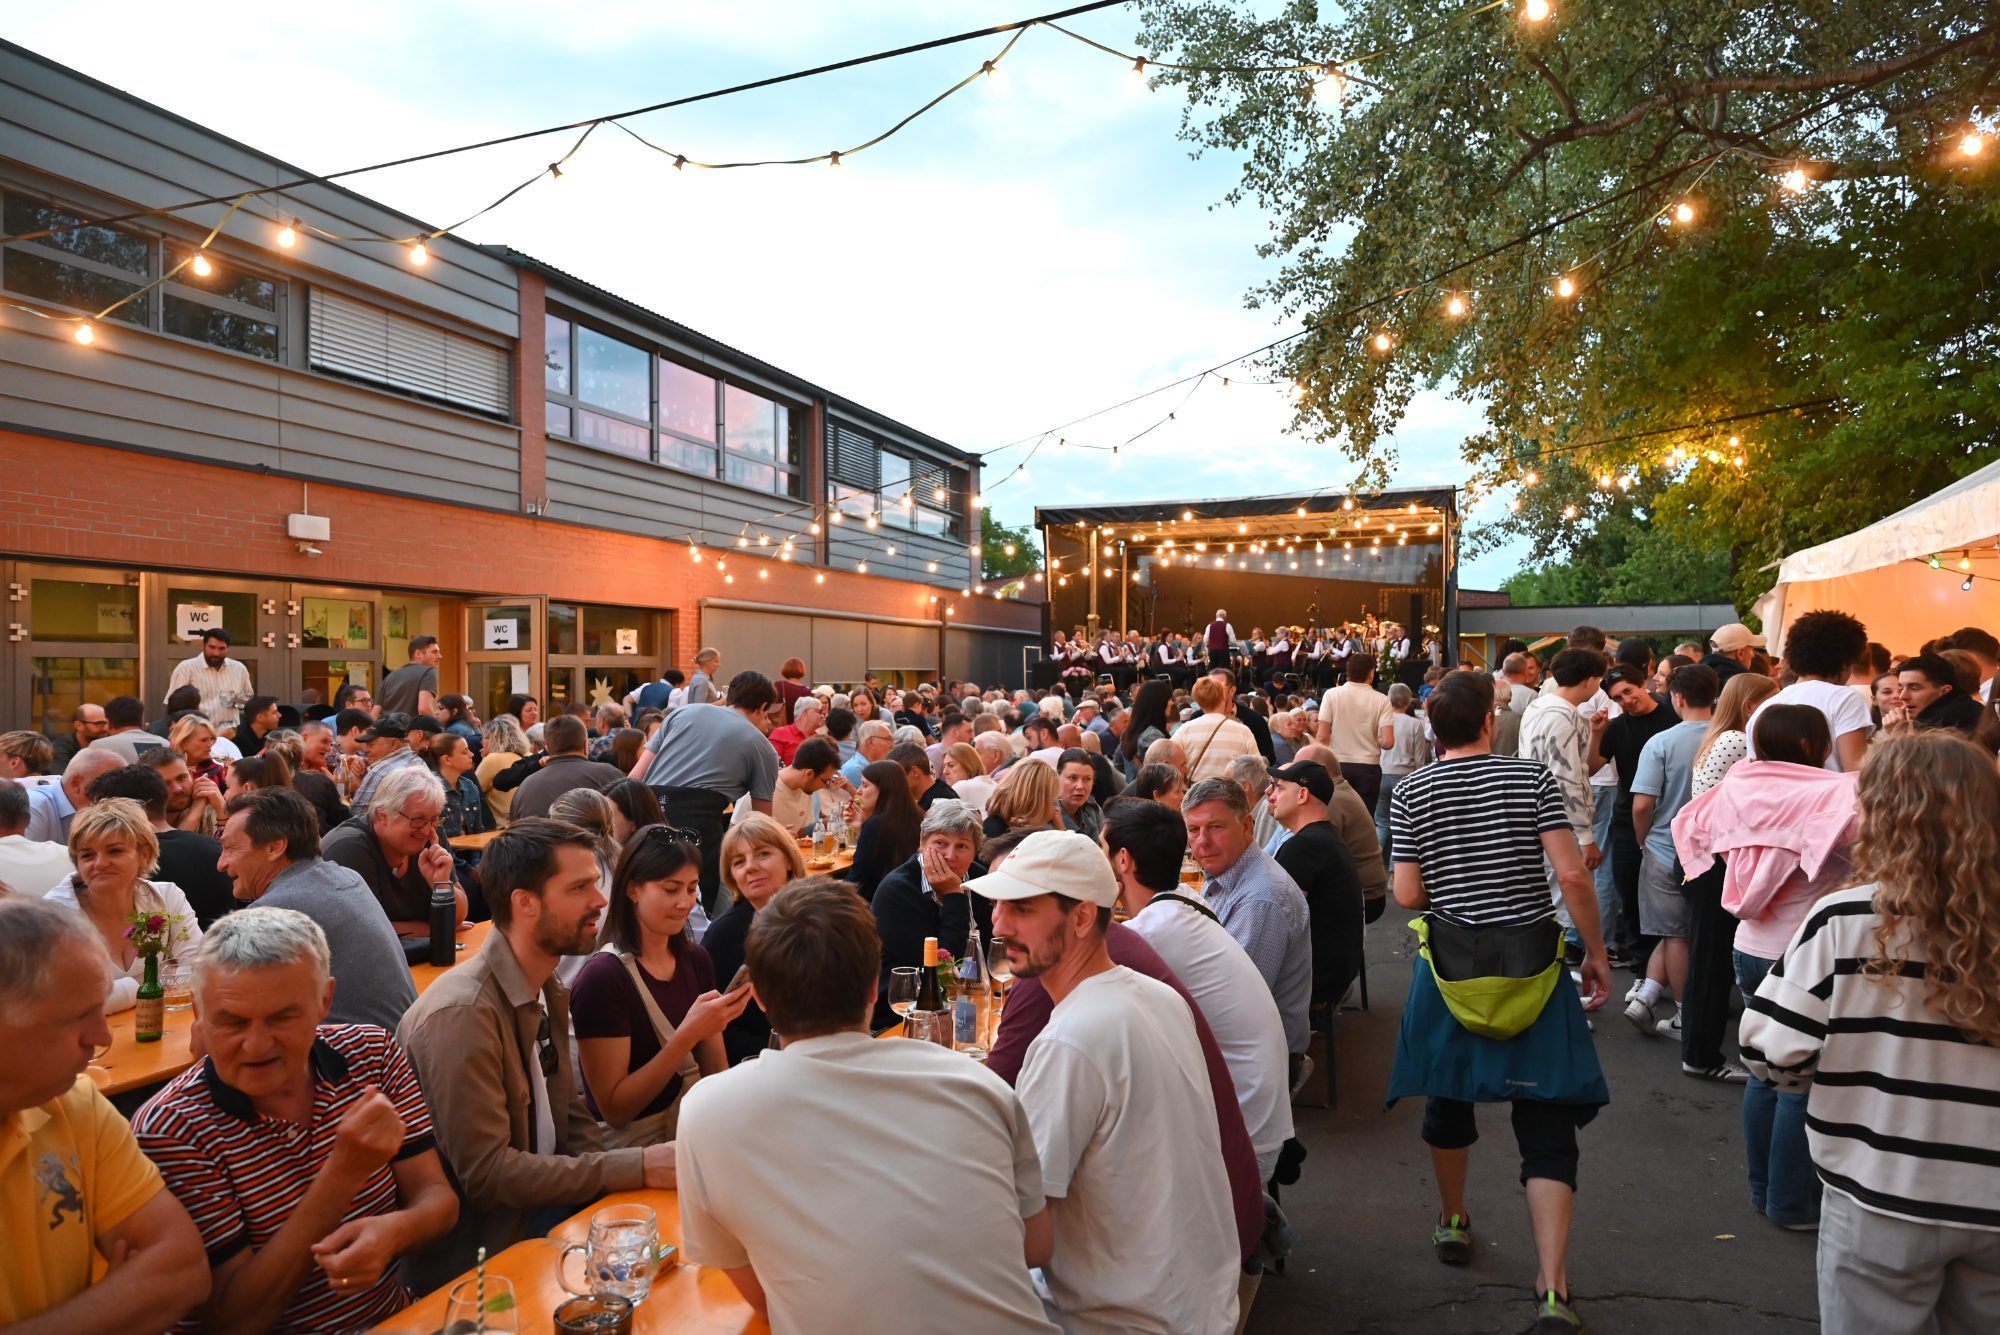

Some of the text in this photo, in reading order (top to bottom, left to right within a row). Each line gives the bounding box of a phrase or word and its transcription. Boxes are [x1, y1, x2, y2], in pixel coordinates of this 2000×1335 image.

[100, 608, 117, 618] WC
[189, 611, 209, 623] WC
[494, 624, 508, 634] WC
[622, 634, 631, 642] WC
